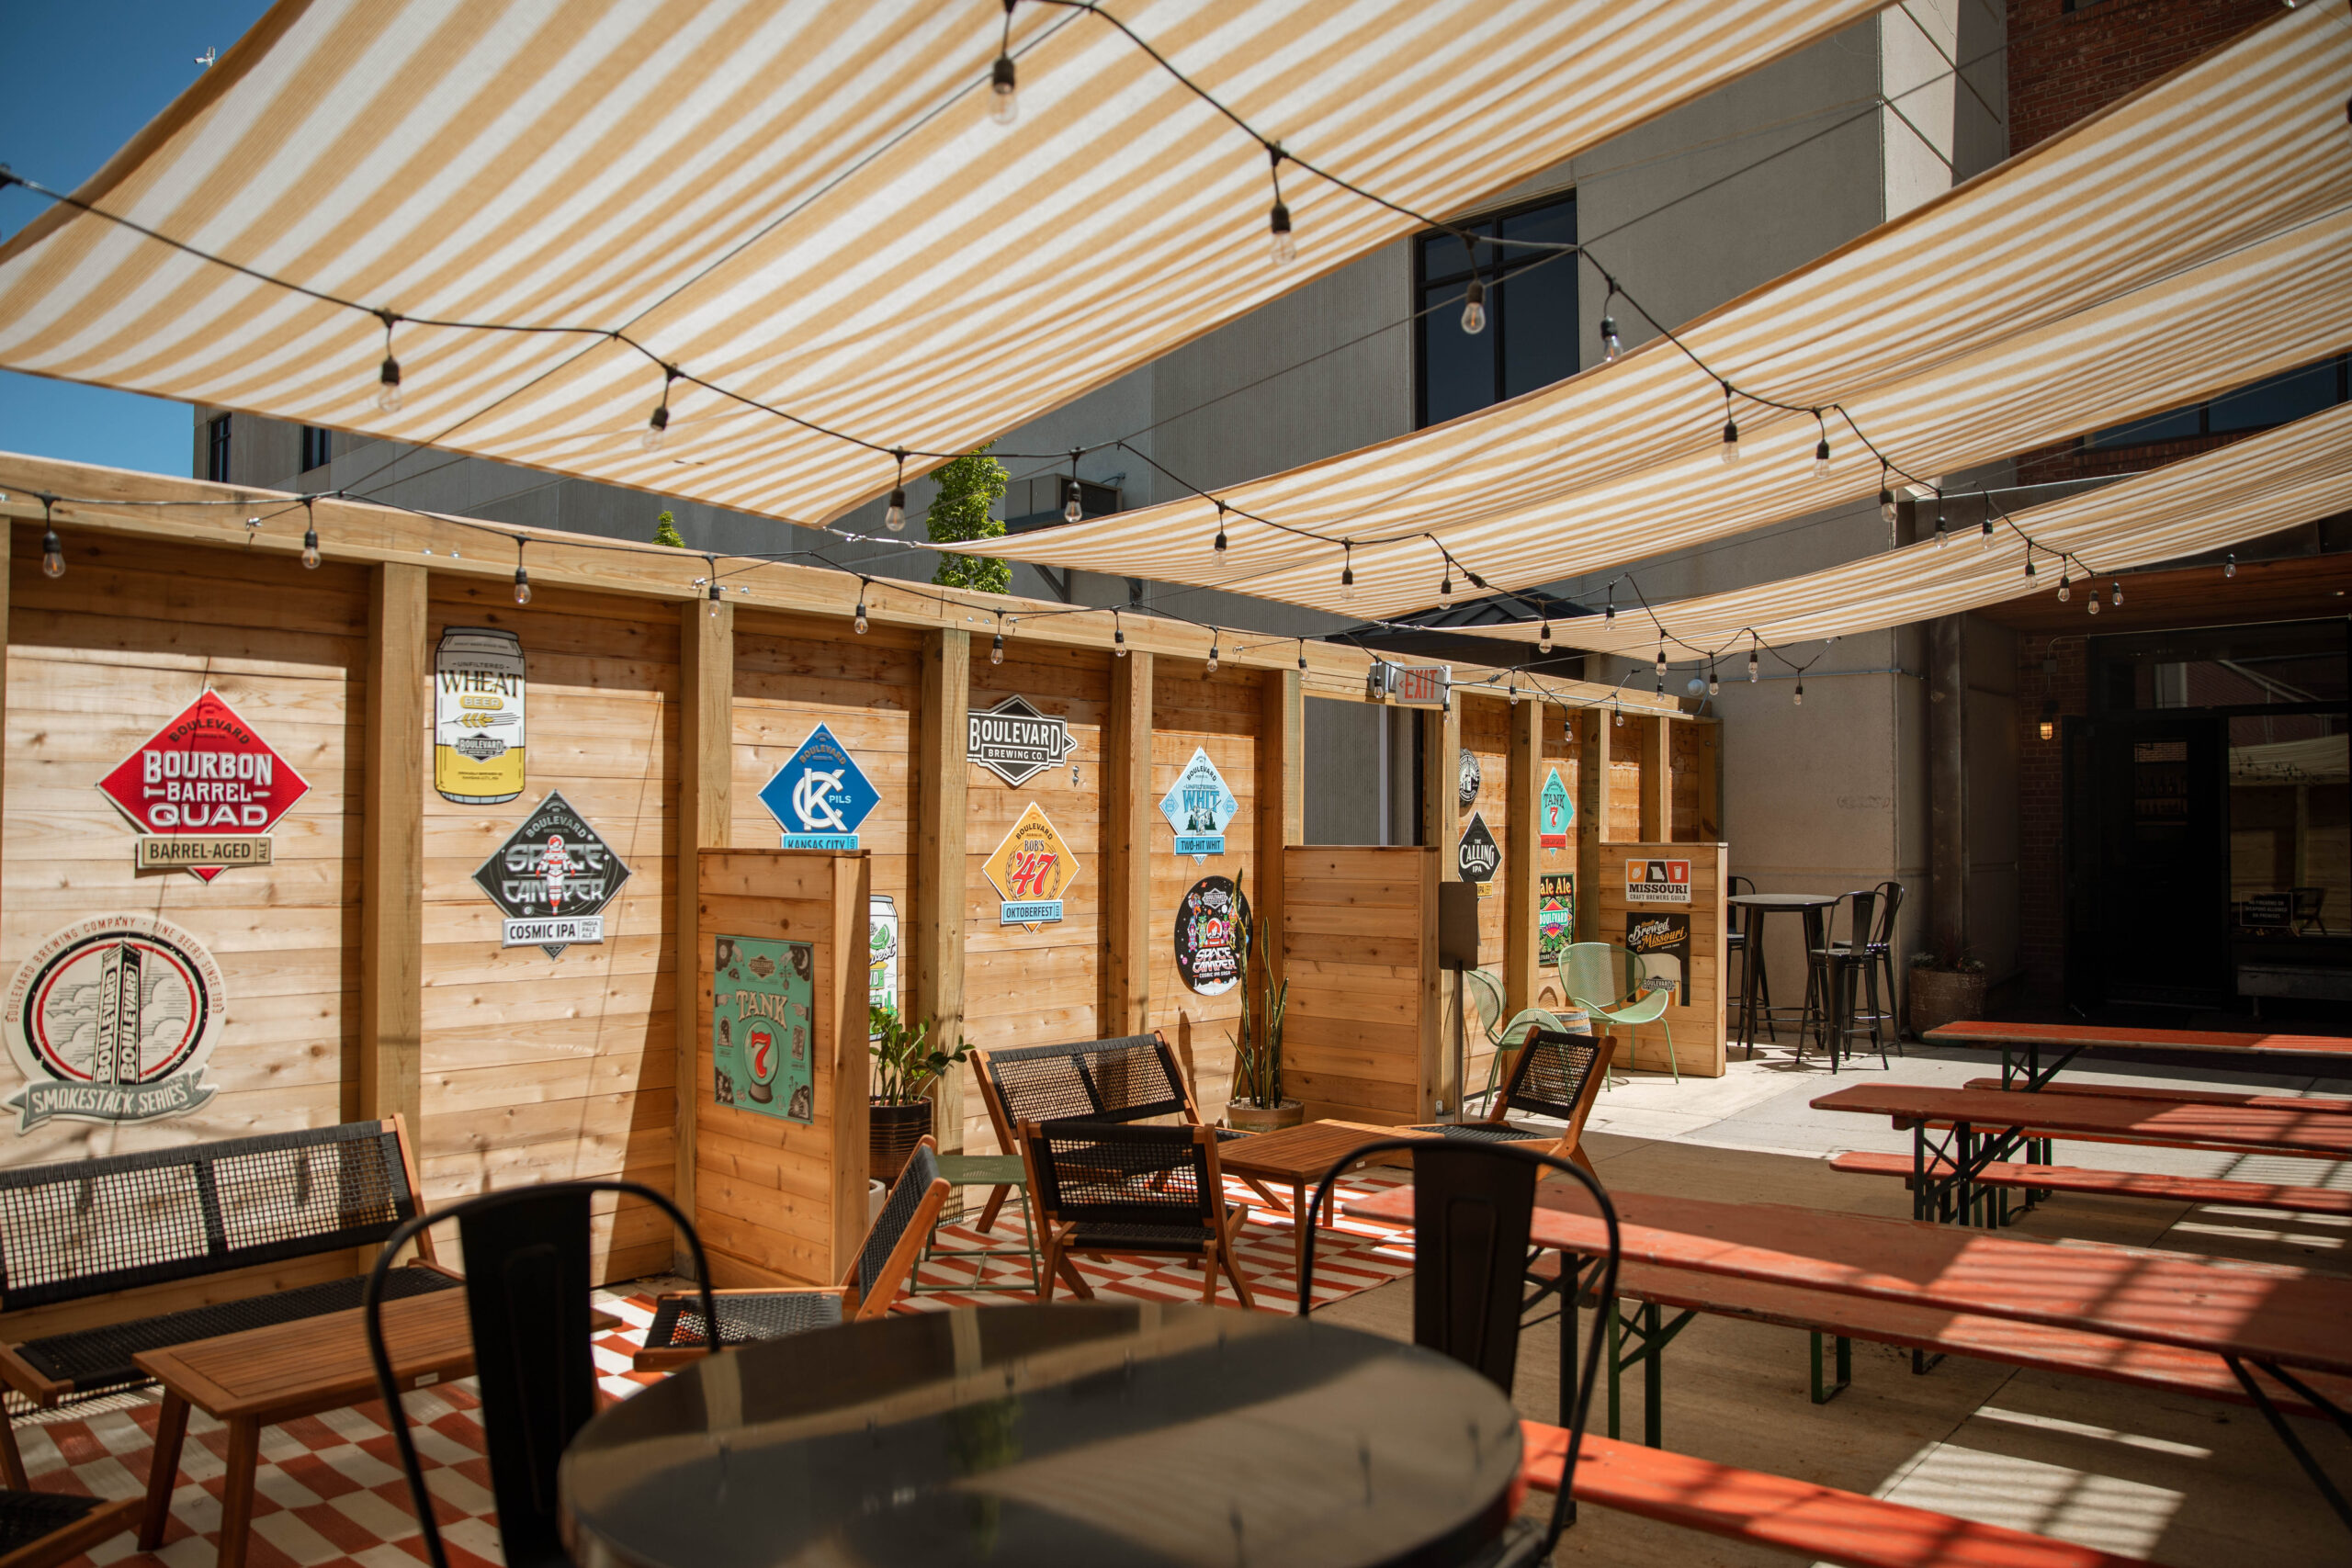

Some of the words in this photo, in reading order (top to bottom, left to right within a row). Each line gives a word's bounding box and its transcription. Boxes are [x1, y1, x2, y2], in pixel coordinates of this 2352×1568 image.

[458, 661, 504, 670] UNFILTERED
[439, 669, 523, 699] WHEAT
[1405, 670, 1438, 699] EXIT
[463, 696, 500, 707] BEER
[168, 718, 250, 745] BOULEVARD
[969, 718, 1060, 756] BOULEVARD
[459, 739, 503, 753] BOULEVARD
[799, 745, 846, 764] BOULEVARD
[988, 749, 1029, 760] BREWING
[1032, 751, 1045, 761] CO.
[142, 750, 273, 786] BOURBON
[1187, 766, 1216, 782] BOULEVARD
[166, 782, 252, 802] BARREL
[829, 795, 852, 804] PILS
[1182, 790, 1220, 813] WHIT
[1544, 794, 1565, 809] TANK
[147, 803, 268, 827] QUAD
[1550, 807, 1558, 827] 7
[526, 816, 586, 838] BOULEVARD
[1016, 823, 1053, 840] BOULEVARD
[149, 842, 251, 860] BARREL-AGED
[258, 840, 267, 859] ALE
[788, 840, 823, 849] KANSAS
[827, 840, 845, 849] CITY
[1024, 840, 1045, 852] BOB'S
[1182, 840, 1204, 851] TWO-HIT
[1206, 840, 1220, 850] WHIT
[505, 844, 604, 871] SPCE
[1459, 844, 1495, 870] CALLING
[1540, 878, 1554, 896] ale
[1555, 876, 1572, 895] Ale
[1629, 885, 1688, 894] MISSOURI
[1006, 906, 1053, 918] OKTOBERFEST
[510, 924, 553, 940] COSMIC
[557, 923, 576, 938] IPA
[1628, 917, 1669, 942] Brewed
[1636, 926, 1687, 952] Missouri
[1195, 947, 1234, 962] SPACE
[6, 965, 35, 1023] BOULEVARD
[33, 928, 79, 964] BREWING
[83, 917, 137, 934] COMPANY
[153, 920, 175, 938] FINE
[177, 934, 205, 959] BEERS
[201, 960, 220, 987] SINCE
[1192, 959, 1238, 973] CAMPER
[736, 990, 788, 1031] TANK
[96, 971, 118, 1082] BOULEVARD
[119, 971, 138, 1080] BOULEVARD
[751, 1030, 772, 1078] 7
[31, 1089, 135, 1114] SMOKESTACK
[138, 1082, 188, 1114] SERIES
